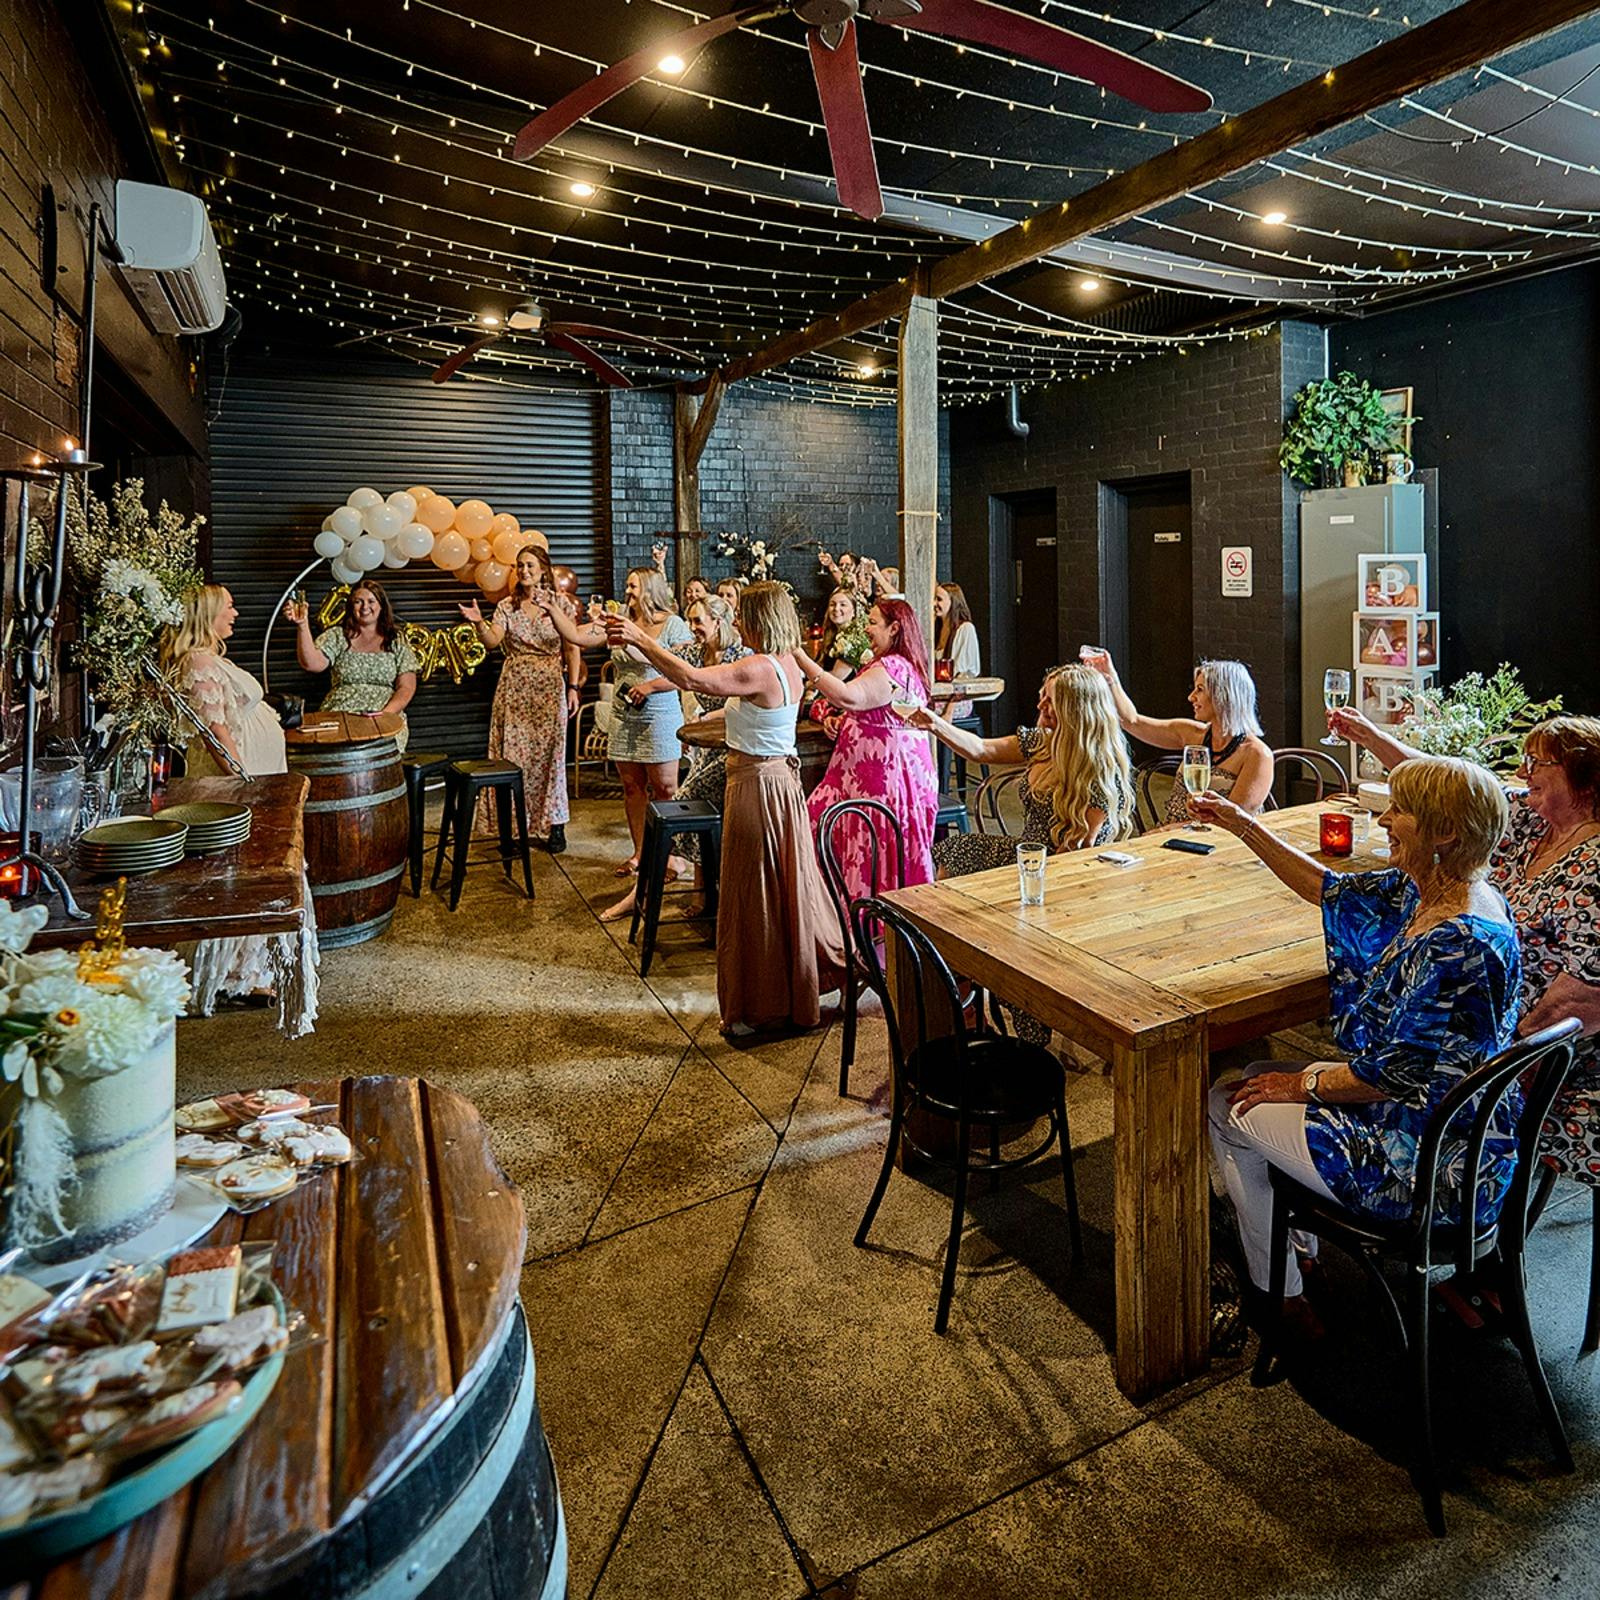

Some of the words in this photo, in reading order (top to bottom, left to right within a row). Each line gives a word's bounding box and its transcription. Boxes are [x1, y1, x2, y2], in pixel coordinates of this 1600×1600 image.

[1376, 568, 1406, 596] B
[403, 621, 493, 685] BAB
[1368, 627, 1397, 656] A
[1376, 683, 1404, 712] B
